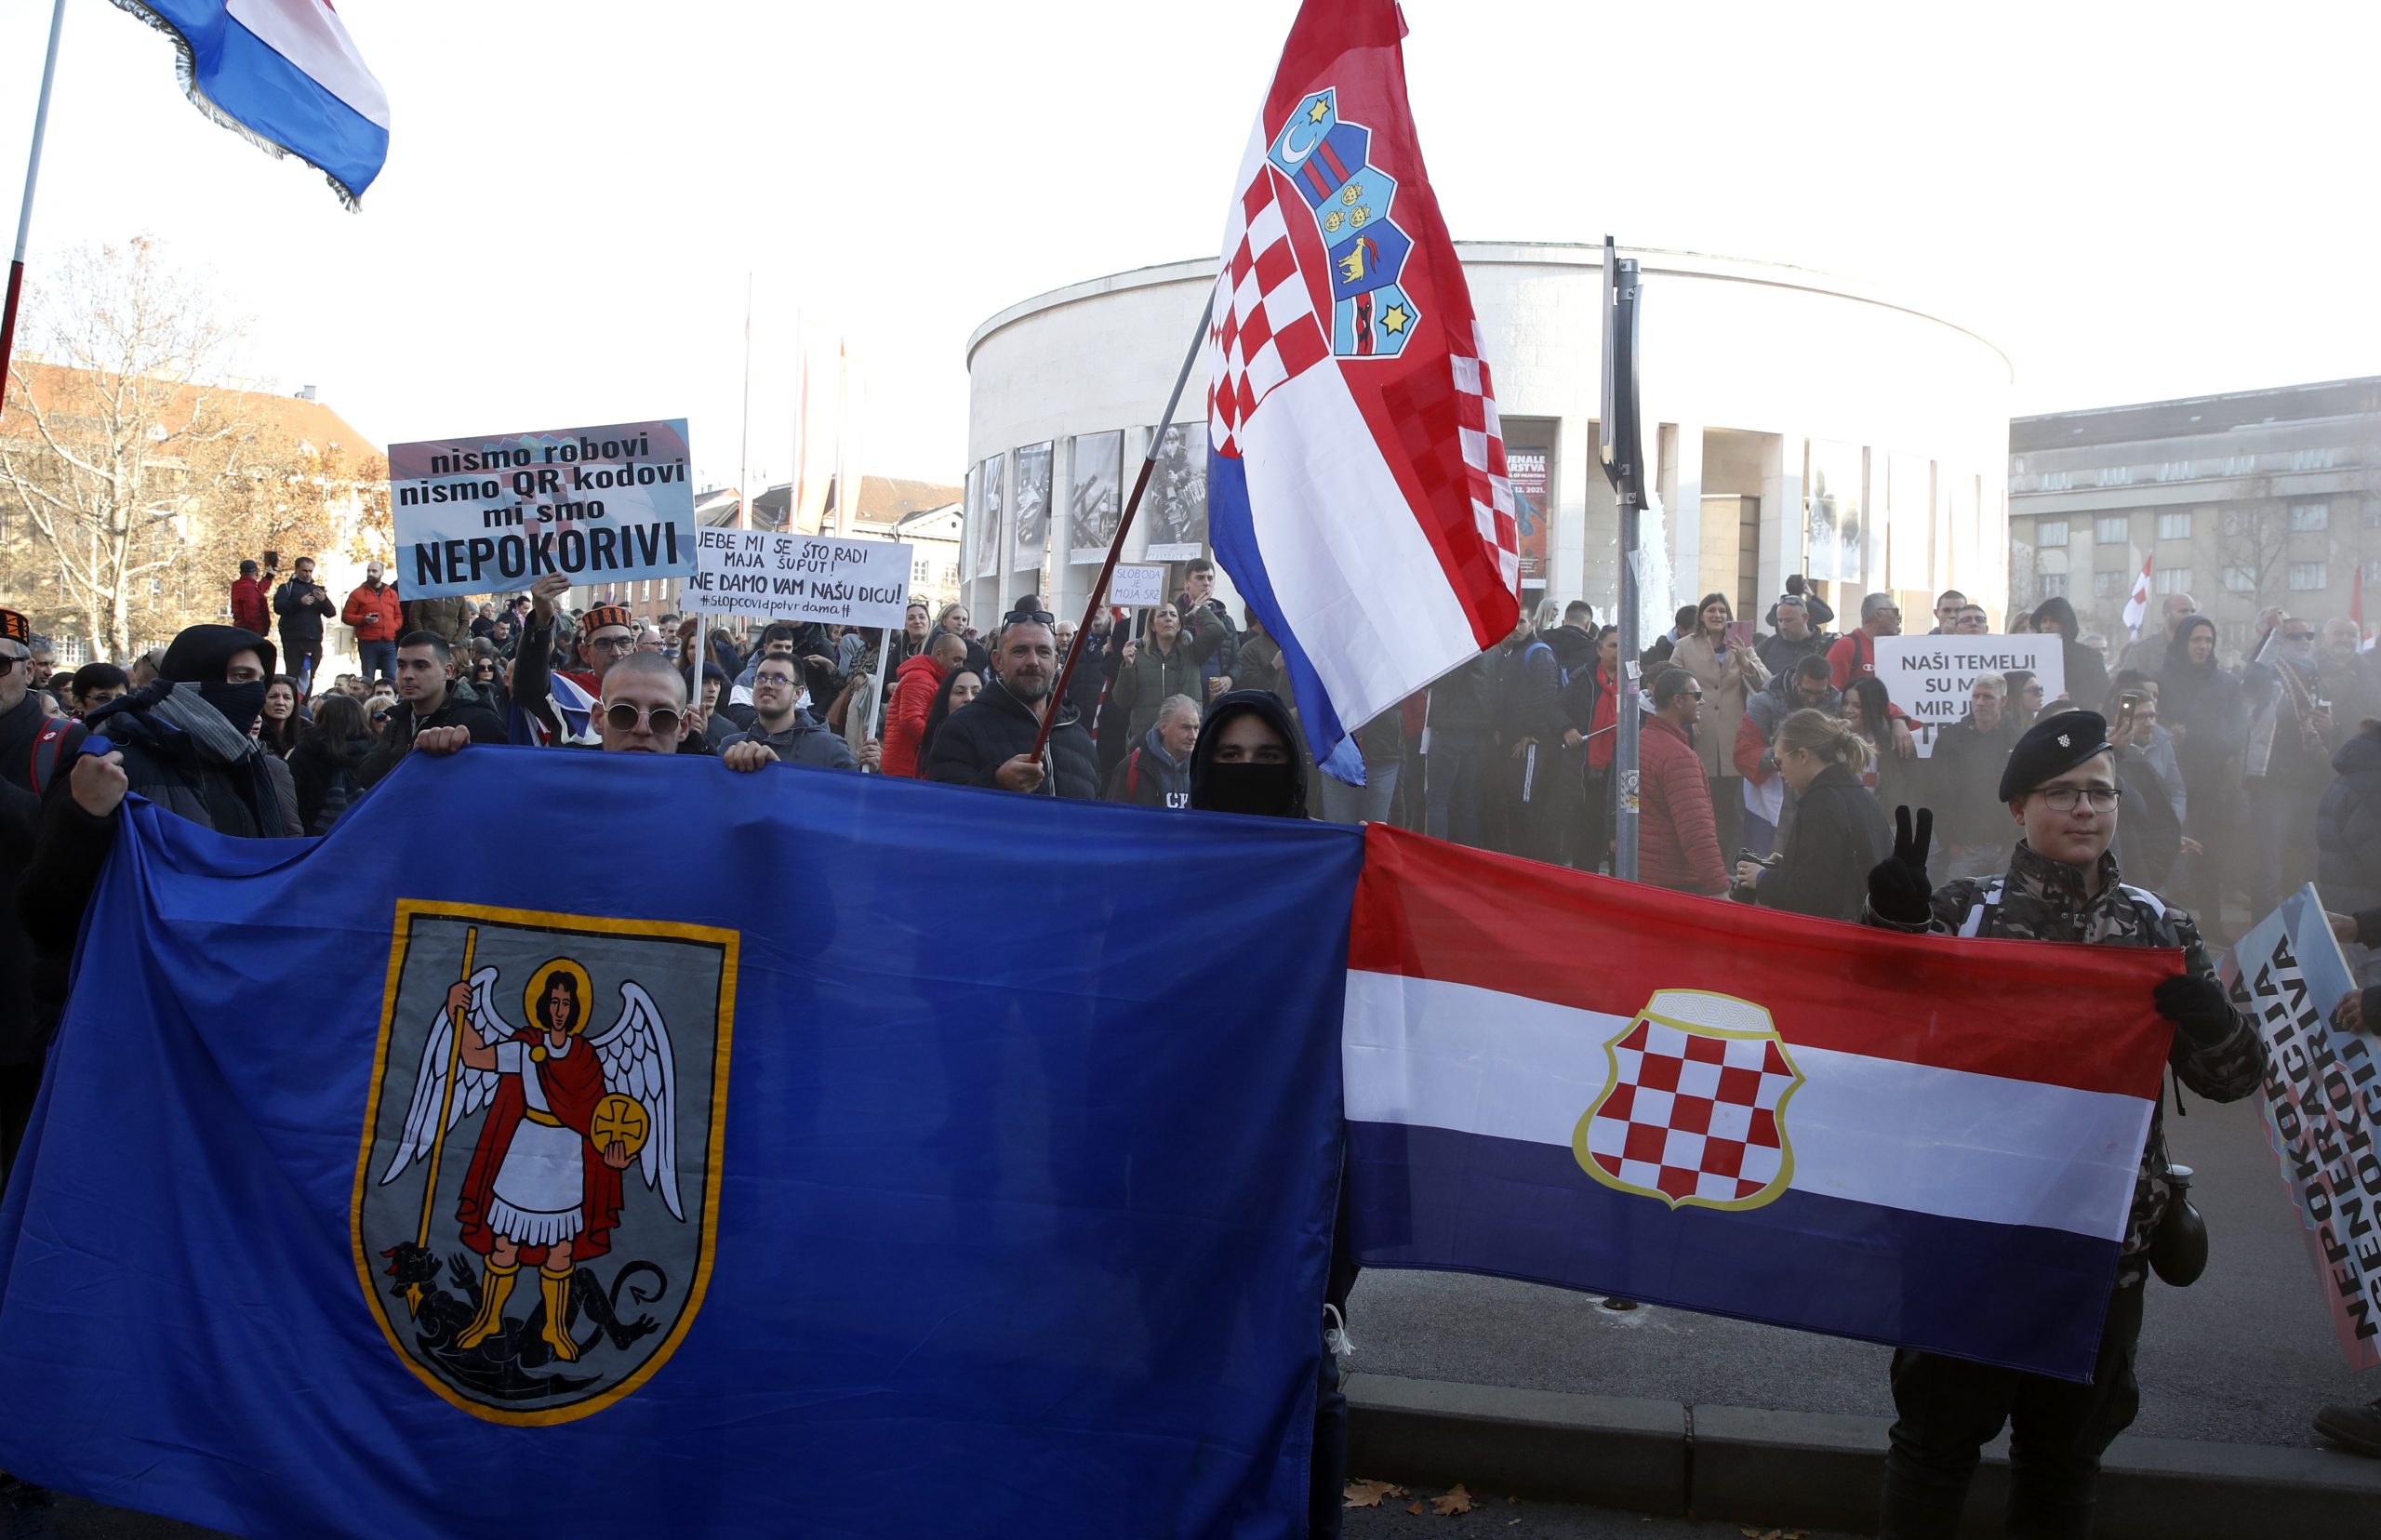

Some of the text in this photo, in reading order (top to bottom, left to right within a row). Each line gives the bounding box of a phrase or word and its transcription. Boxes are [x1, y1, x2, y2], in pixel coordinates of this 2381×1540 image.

[432, 431, 649, 473] nismo robovi
[1507, 455, 1546, 464] JENALE
[1508, 463, 1545, 472] RSTVA
[400, 458, 685, 506] nismo QR kodovi
[483, 499, 605, 527] mi smo
[415, 522, 678, 586] NEPOKORIVI
[745, 536, 765, 551] MI
[774, 538, 792, 555] SE
[803, 541, 829, 560] ŠTO
[834, 547, 868, 564] RADI
[725, 551, 765, 568] MAJA
[1117, 568, 1161, 579] SLOBODA
[689, 572, 902, 604] NE DAMO VAM NAŠU DICU!
[1131, 579, 1141, 588] JE
[1115, 589, 1140, 598] MOJA
[1902, 652, 2036, 670] NAŠI TEMELJI
[1925, 678, 1951, 693] SU
[1915, 701, 1955, 715] MIR
[2272, 933, 2381, 1229] OKORIVA
[2229, 970, 2379, 1340] NEPOKORA
